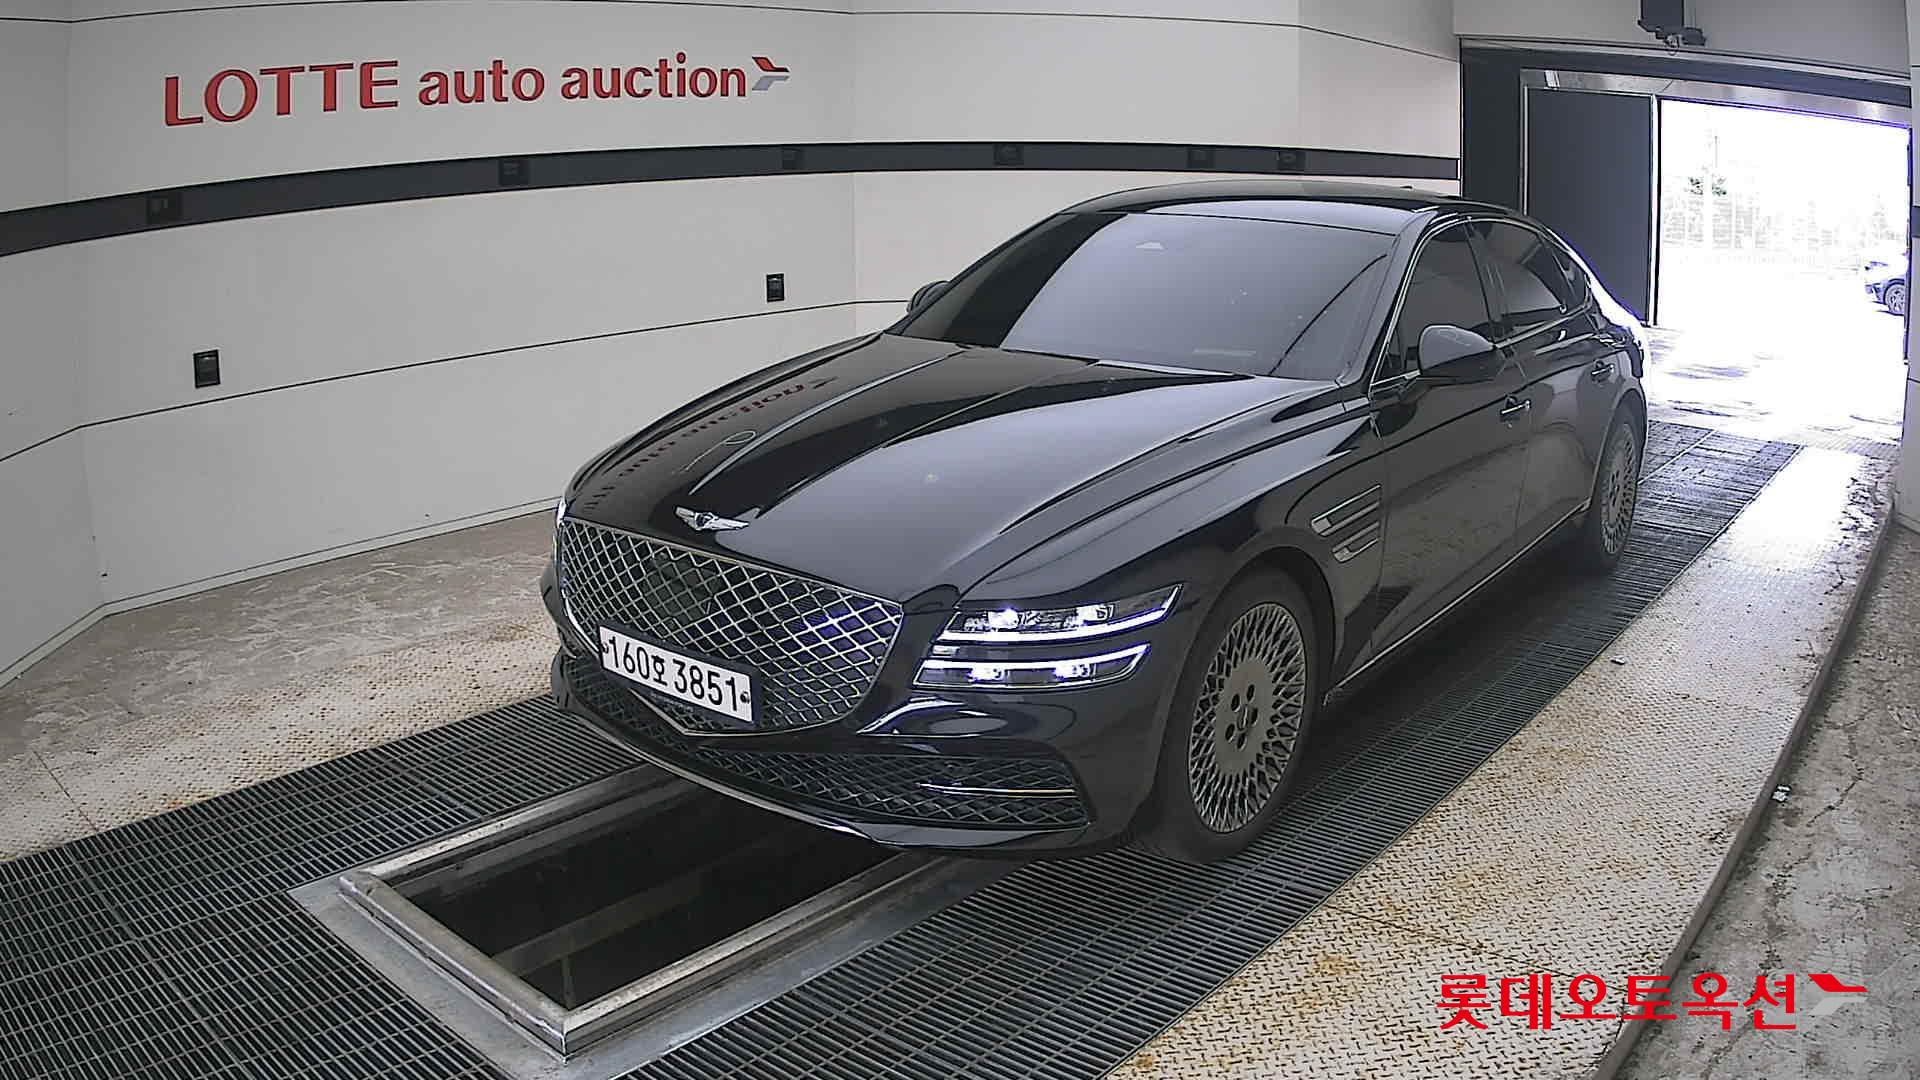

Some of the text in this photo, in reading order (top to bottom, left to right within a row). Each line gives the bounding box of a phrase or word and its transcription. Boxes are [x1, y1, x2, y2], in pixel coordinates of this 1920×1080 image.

[165, 52, 746, 126] LOTTE auto auction
[608, 636, 737, 712] 160호 3851
